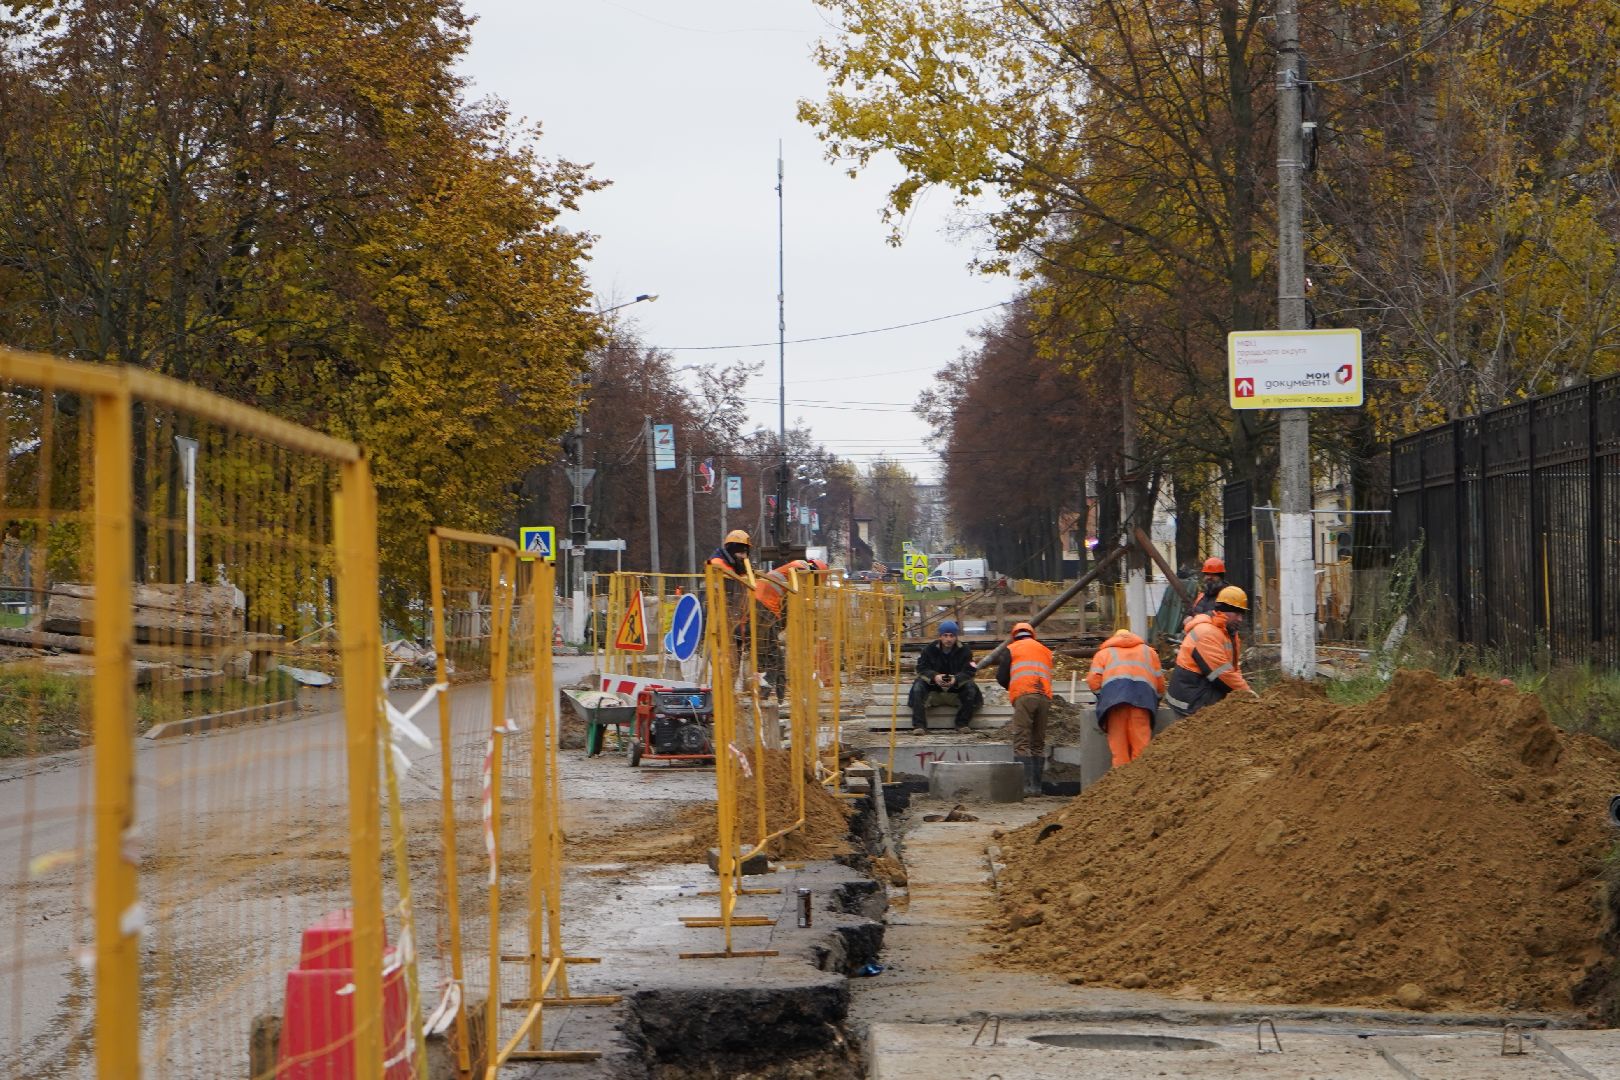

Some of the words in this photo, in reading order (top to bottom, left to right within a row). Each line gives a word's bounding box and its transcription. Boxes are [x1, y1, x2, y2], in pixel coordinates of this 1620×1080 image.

[1306, 372, 1330, 380] мои
[1265, 379, 1331, 390] документы
[658, 429, 670, 444] Z
